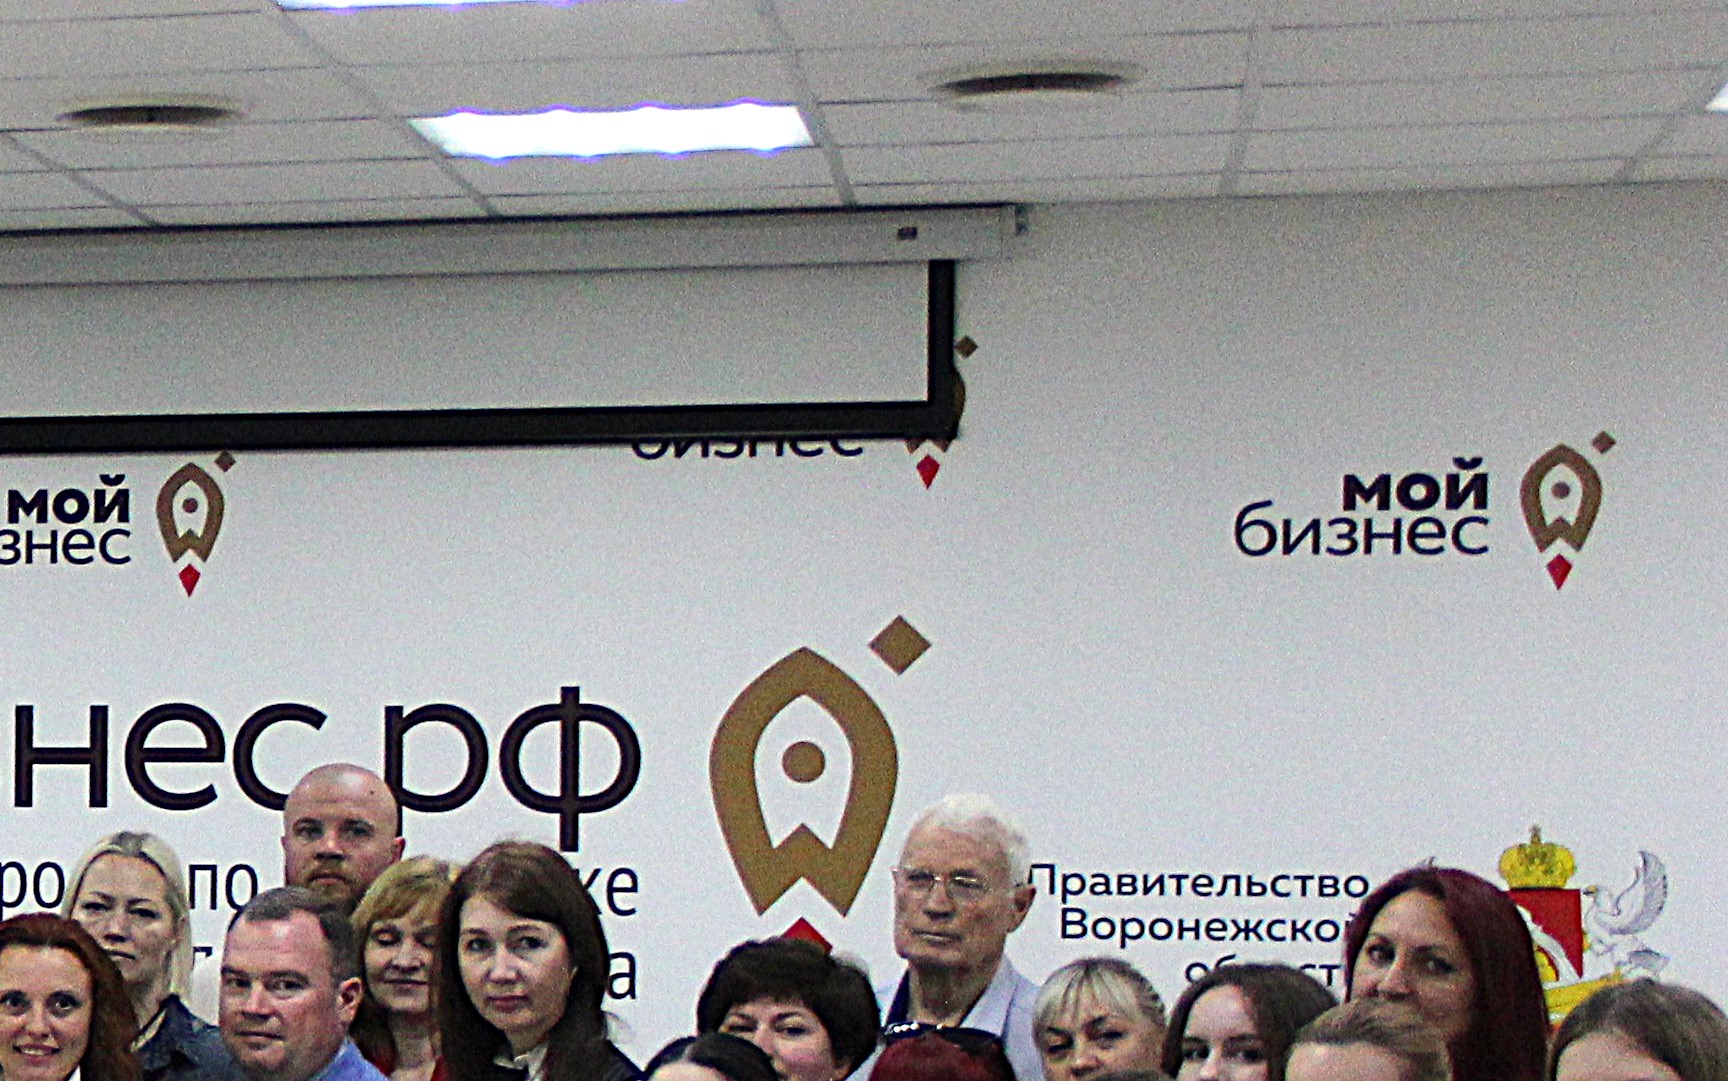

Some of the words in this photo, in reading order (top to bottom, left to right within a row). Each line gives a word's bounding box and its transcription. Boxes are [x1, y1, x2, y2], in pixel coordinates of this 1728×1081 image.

[8, 474, 130, 525] мой
[1343, 457, 1489, 511] мой
[1234, 500, 1490, 557] бизнес
[1028, 863, 1370, 904] Правительство
[1060, 906, 1348, 948] Воронежско
